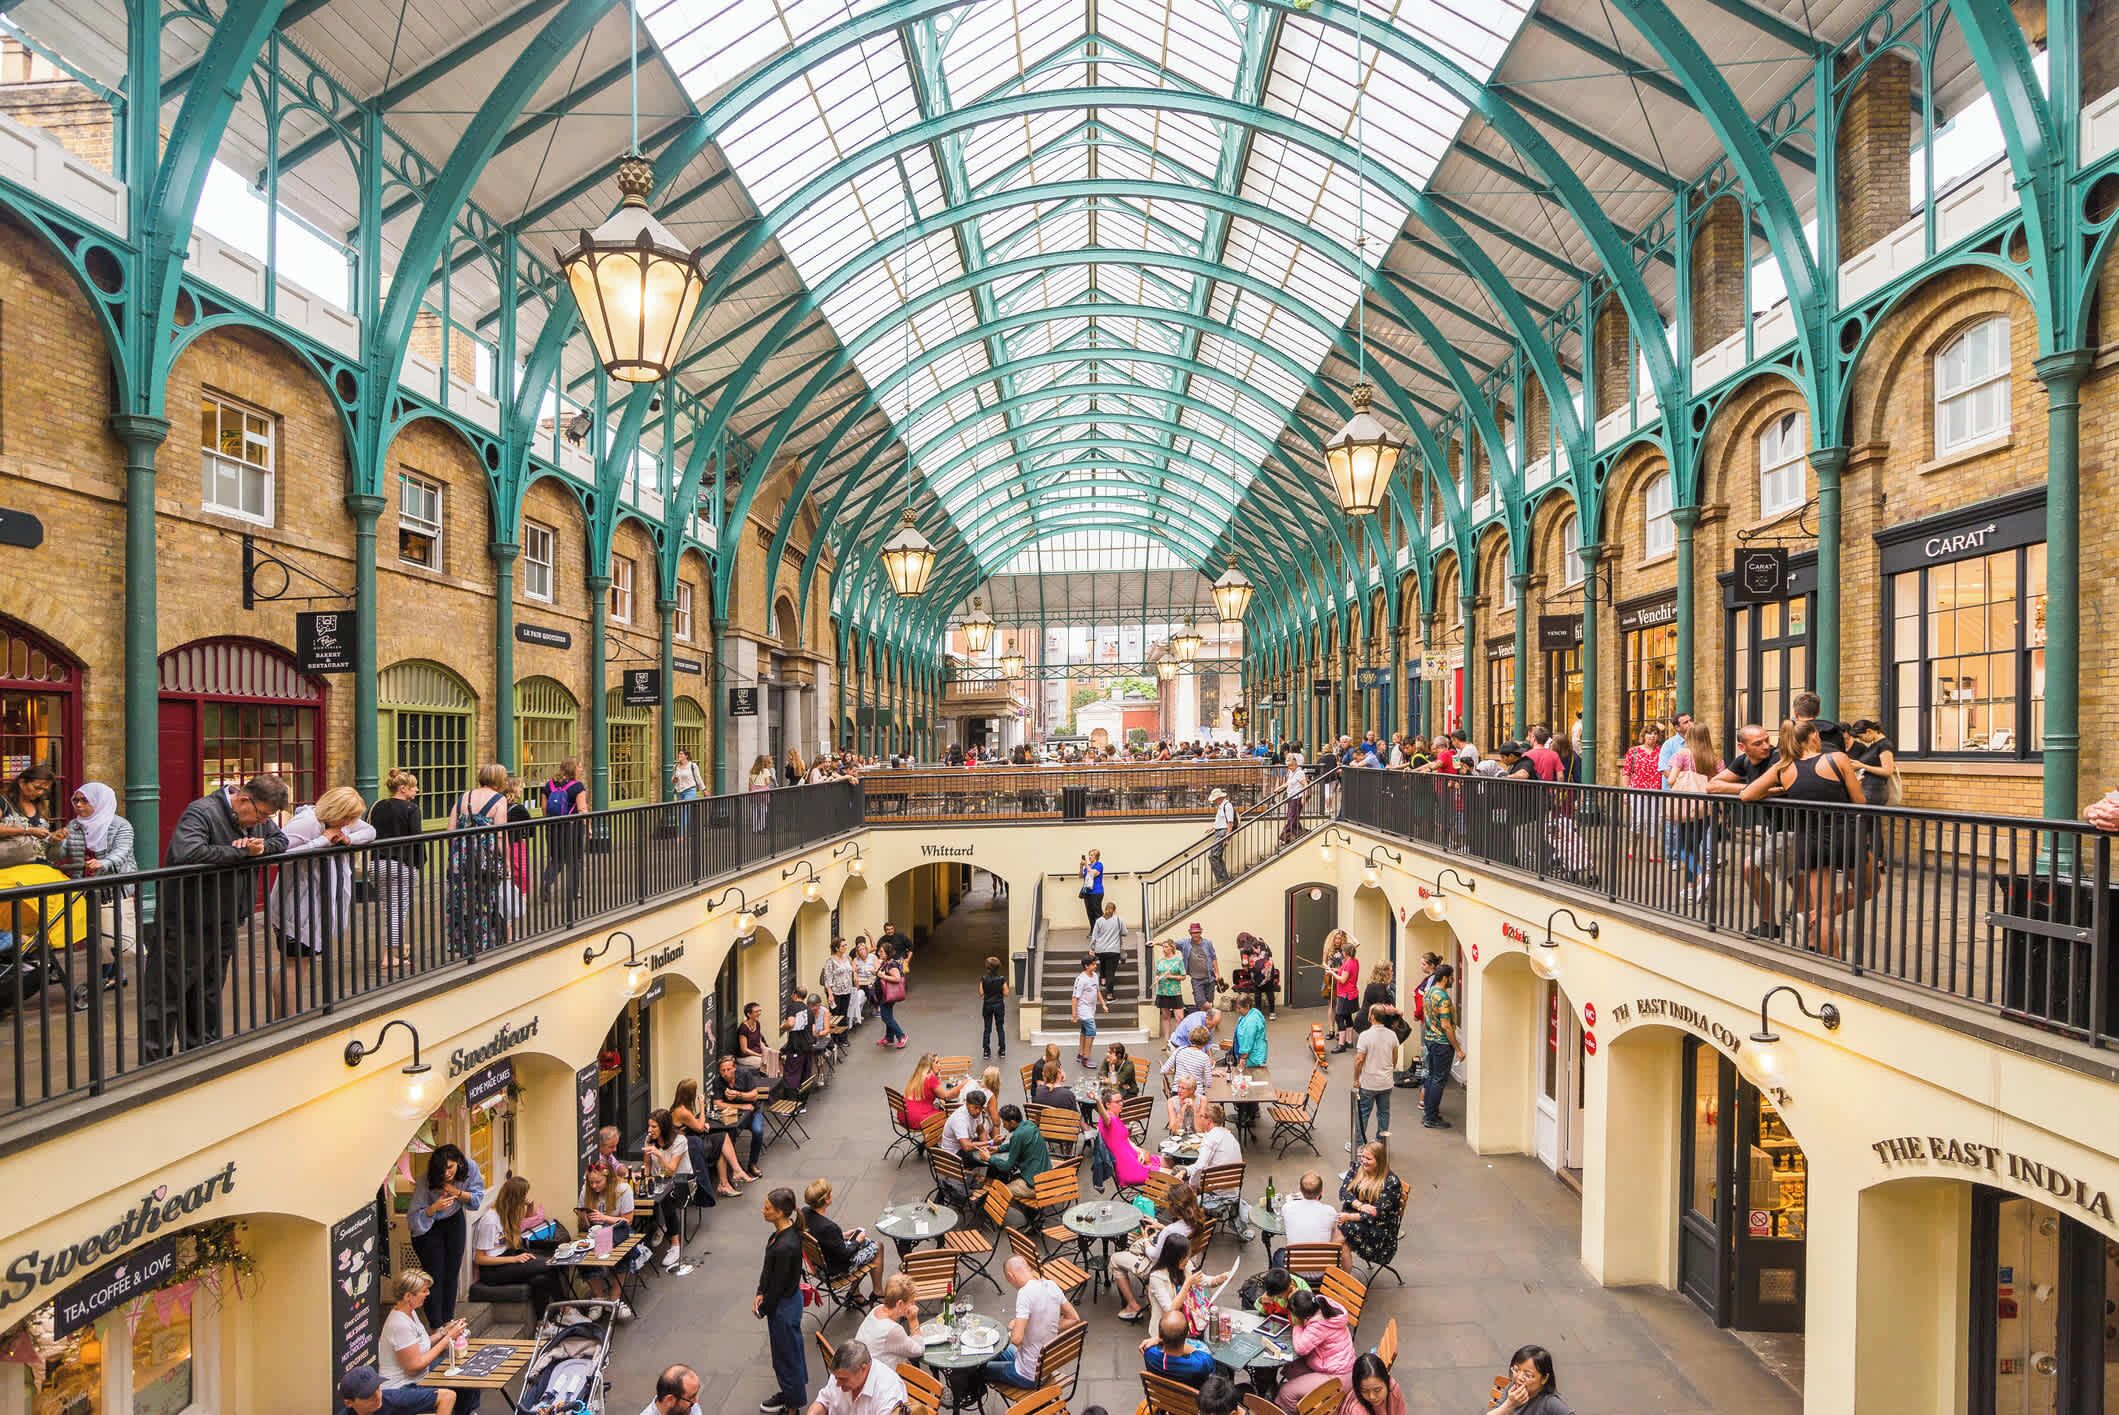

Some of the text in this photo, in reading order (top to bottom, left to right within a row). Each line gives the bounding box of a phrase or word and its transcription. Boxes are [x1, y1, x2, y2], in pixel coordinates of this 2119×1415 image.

[1637, 603, 1671, 624] Venchi
[920, 844, 974, 856] Whittard
[651, 940, 684, 971] Italiani
[1636, 999, 1669, 1014] EAST
[1669, 1003, 1710, 1033] INDIA
[449, 1015, 539, 1078] Sweetheart
[1872, 1136, 2115, 1224] THE EAST INDIA
[0, 1161, 238, 1309] Sweetheart
[133, 1271, 142, 1287] &
[144, 1252, 172, 1281] LOVE
